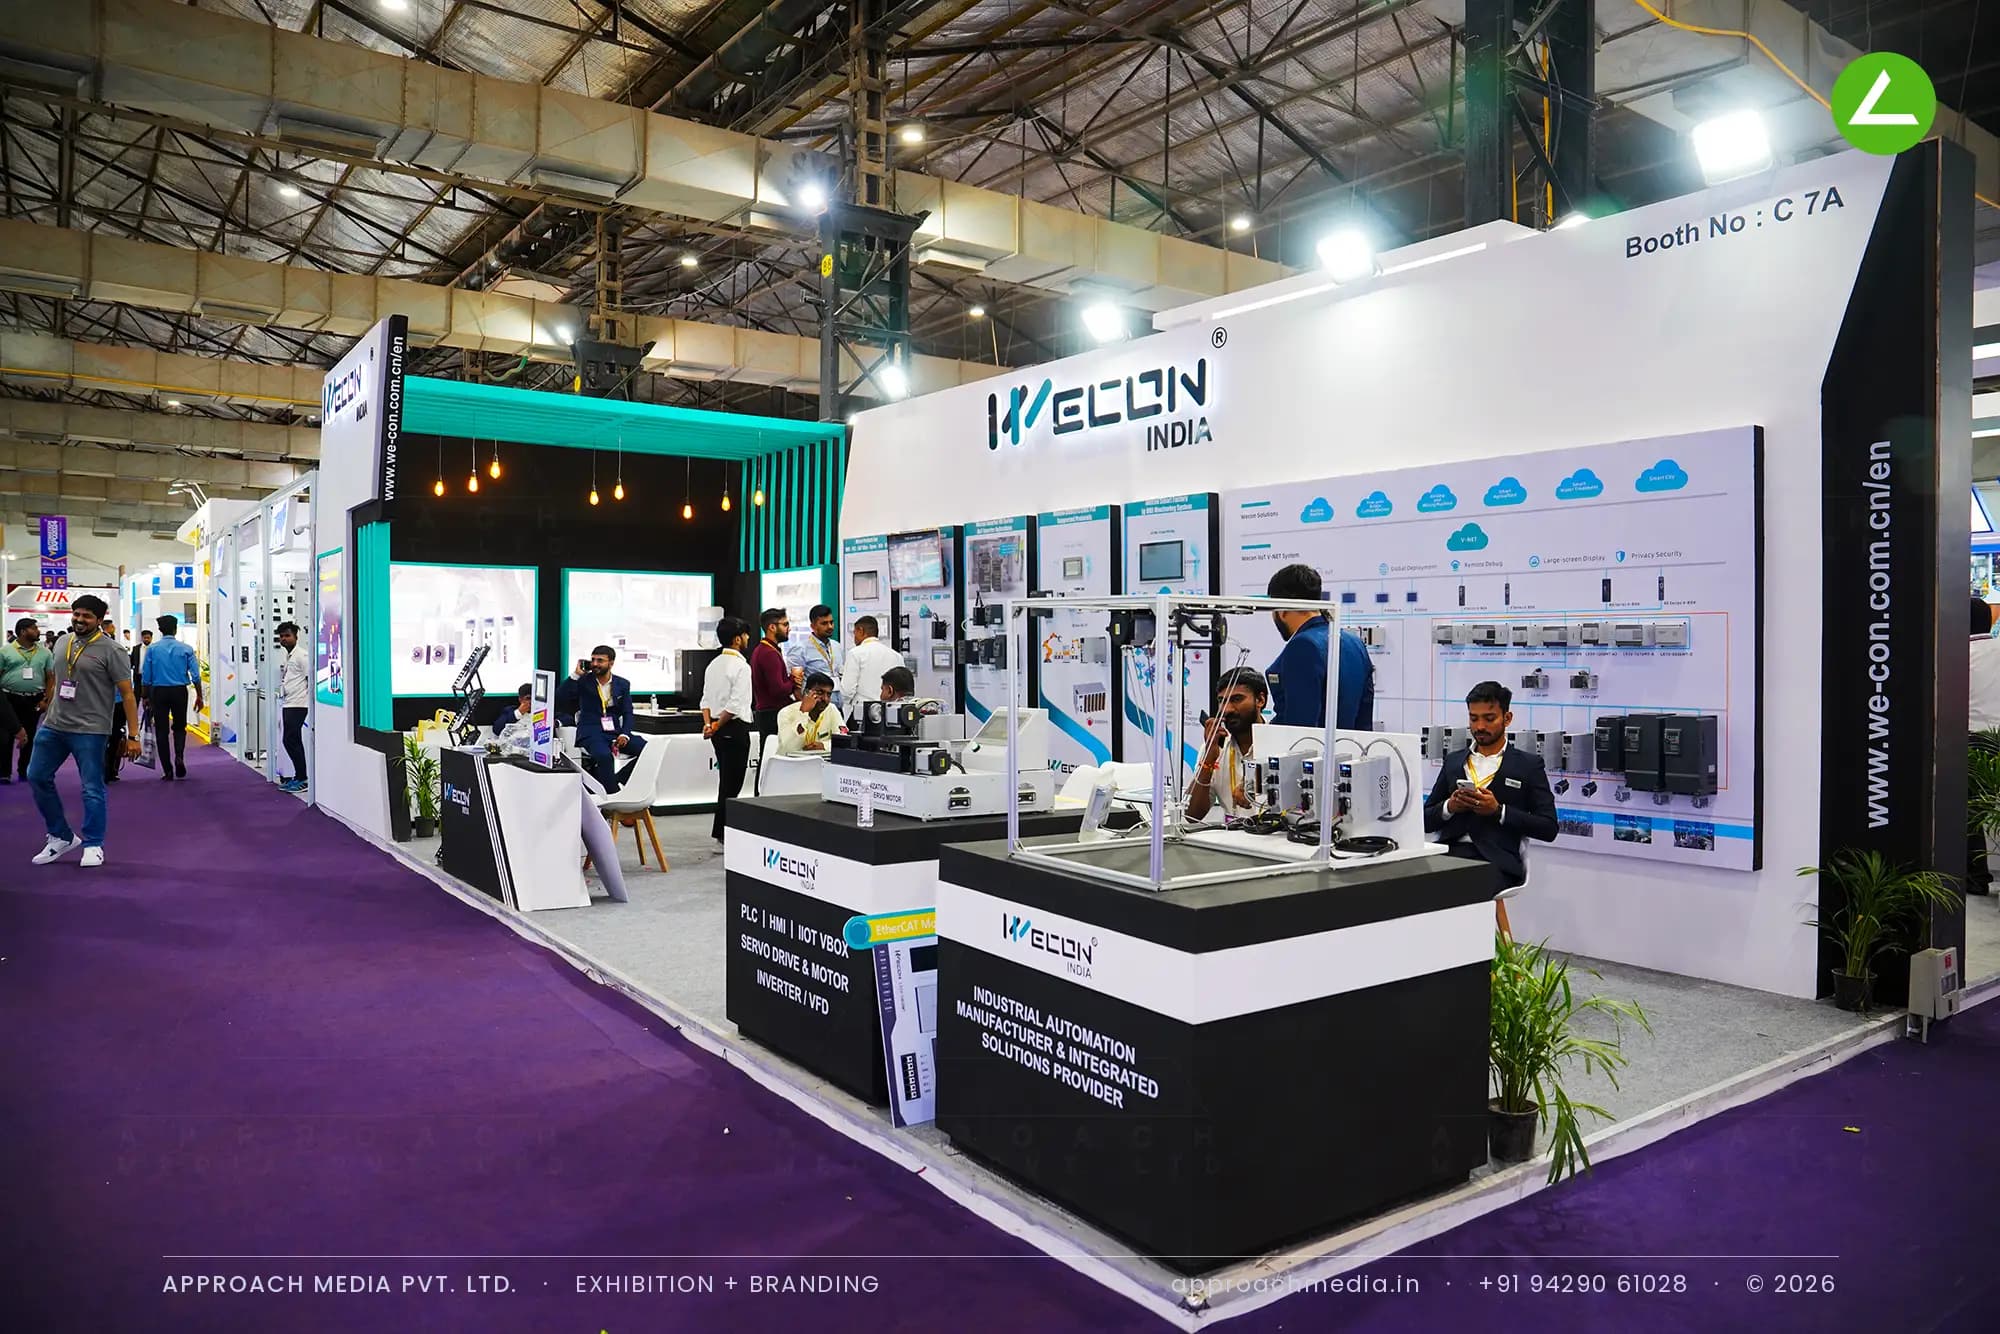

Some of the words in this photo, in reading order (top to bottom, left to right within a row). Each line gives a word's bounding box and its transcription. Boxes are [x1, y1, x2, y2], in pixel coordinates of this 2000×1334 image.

[1625, 223, 1699, 258] Booth
[1709, 213, 1746, 238] No
[1774, 198, 1793, 222] C
[1804, 186, 1844, 215] 7A
[385, 336, 404, 501] www.we-con.com.cn/en
[988, 358, 1206, 450] WECON
[1147, 416, 1213, 452] INDIA
[1257, 511, 1279, 519] Solutions
[1282, 552, 1299, 560] System
[1485, 559, 1503, 568] Debug
[1543, 557, 1580, 566] Large-screen
[1582, 554, 1606, 564] Display
[1631, 551, 1653, 561] Privacy
[1655, 550, 1682, 560] Security
[1862, 440, 1892, 829] www.we-con.com.cn/en
[886, 793, 902, 803] MOTOR
[763, 847, 816, 881] WECON
[741, 903, 758, 924] PLC
[769, 914, 786, 933] HMI
[798, 924, 817, 945] IIOT
[820, 929, 849, 959] VBOX
[875, 919, 918, 937] EtherCAT
[1003, 912, 1092, 965] WECON
[741, 934, 770, 959] SERVO
[772, 945, 800, 972] DRIVE
[802, 959, 809, 975] &
[811, 963, 849, 993] MOTOR
[1066, 962, 1092, 979] INDIA
[756, 968, 801, 1002] INVERTER
[809, 992, 829, 1016] VFD
[973, 985, 1043, 1028] INDUSTRIAL
[1046, 1014, 1136, 1065] AUTOMATION
[956, 1000, 1053, 1054] MANUFACTURER
[1056, 1041, 1066, 1059] &
[1069, 1046, 1159, 1099] INTEGRATED
[981, 1032, 1050, 1076] SOLUTIONS
[1053, 1062, 1124, 1109] PROVIDER
